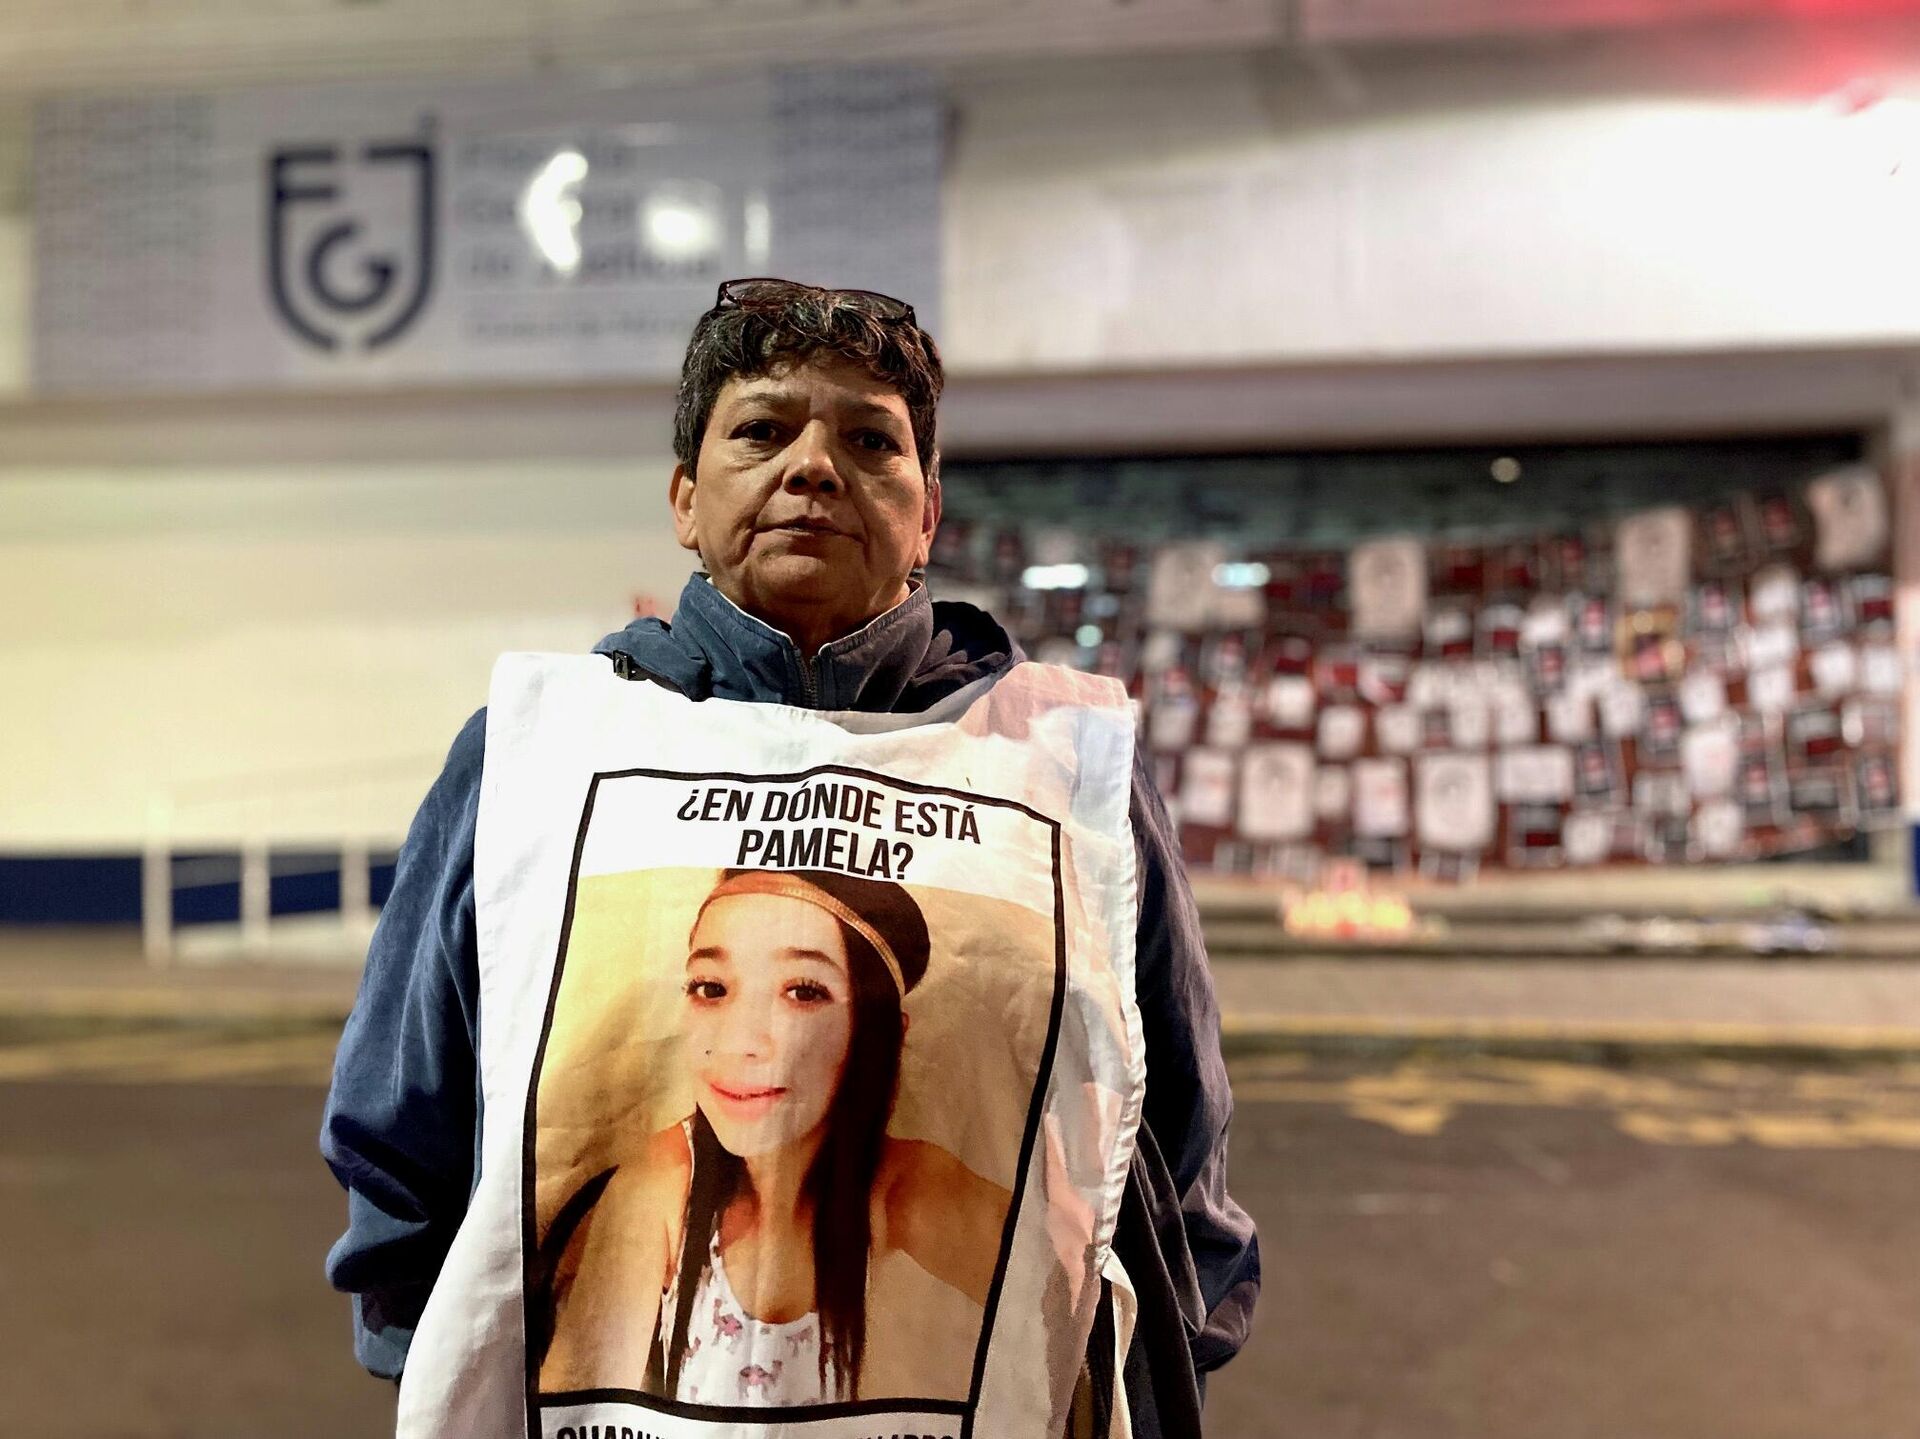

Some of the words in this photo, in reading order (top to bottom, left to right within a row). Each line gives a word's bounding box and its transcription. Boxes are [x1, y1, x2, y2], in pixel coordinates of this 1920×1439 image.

[677, 788, 753, 821] ¿EN
[760, 781, 885, 829] DÓNDE
[895, 799, 981, 844] ESTÁ
[736, 827, 914, 880] PAMELA?
